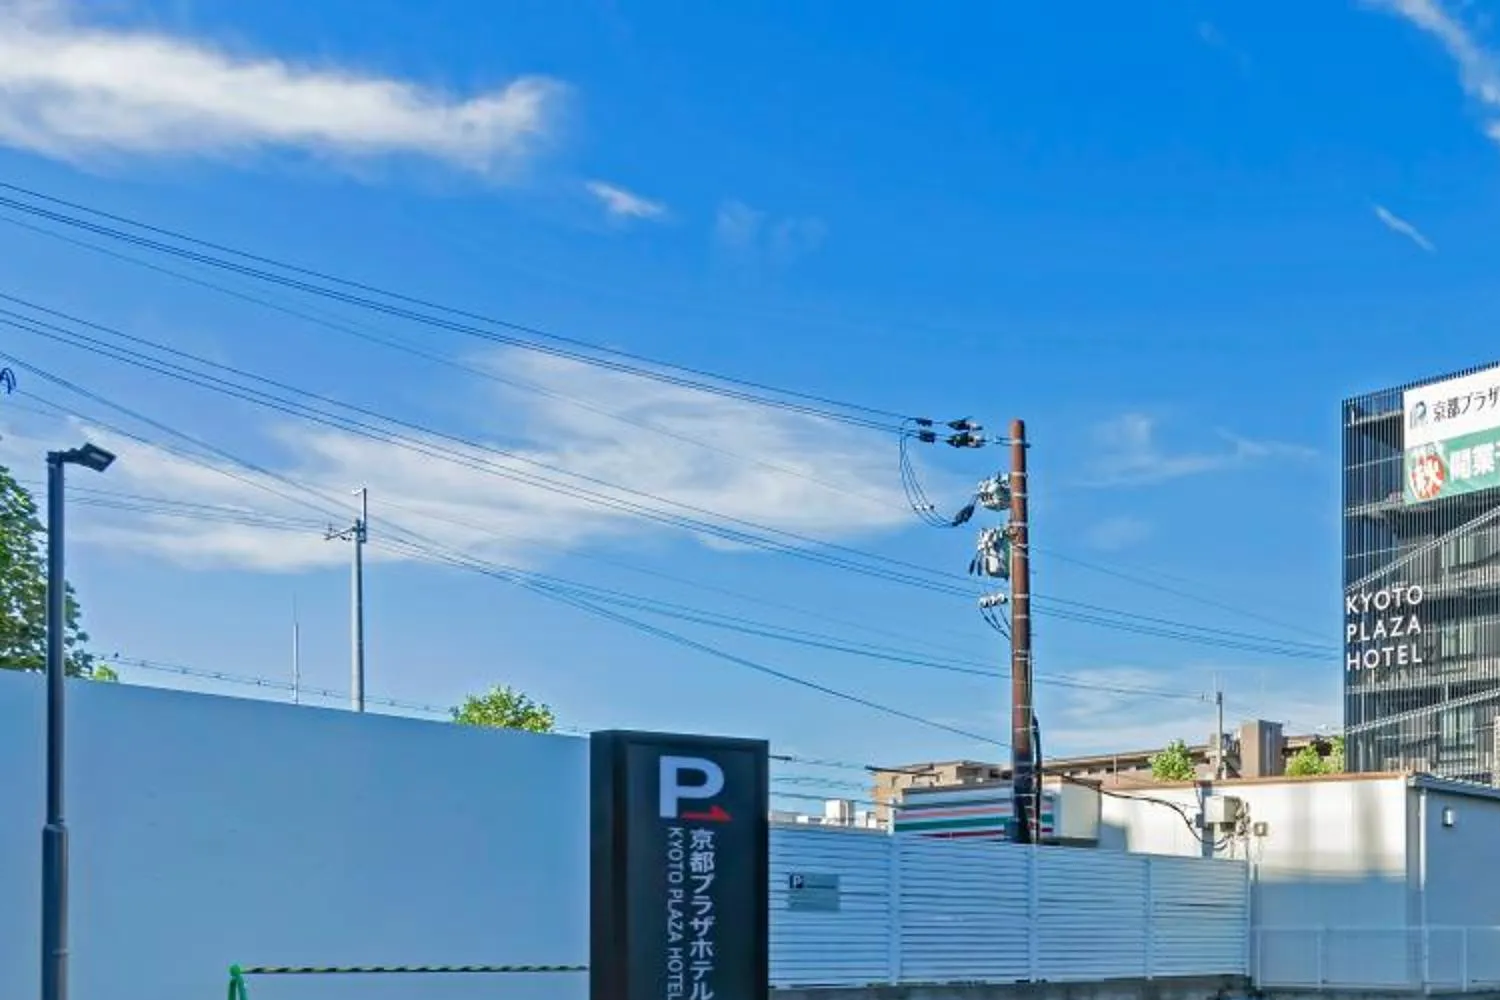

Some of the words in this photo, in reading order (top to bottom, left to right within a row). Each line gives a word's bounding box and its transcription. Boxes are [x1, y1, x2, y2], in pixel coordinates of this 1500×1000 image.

[1347, 585, 1423, 614] KYOTO
[1347, 615, 1421, 642] PLAZA
[1347, 644, 1422, 670] HOTEL
[659, 755, 725, 818] P
[668, 827, 684, 884] KYOTO
[668, 889, 684, 942] PLAZA
